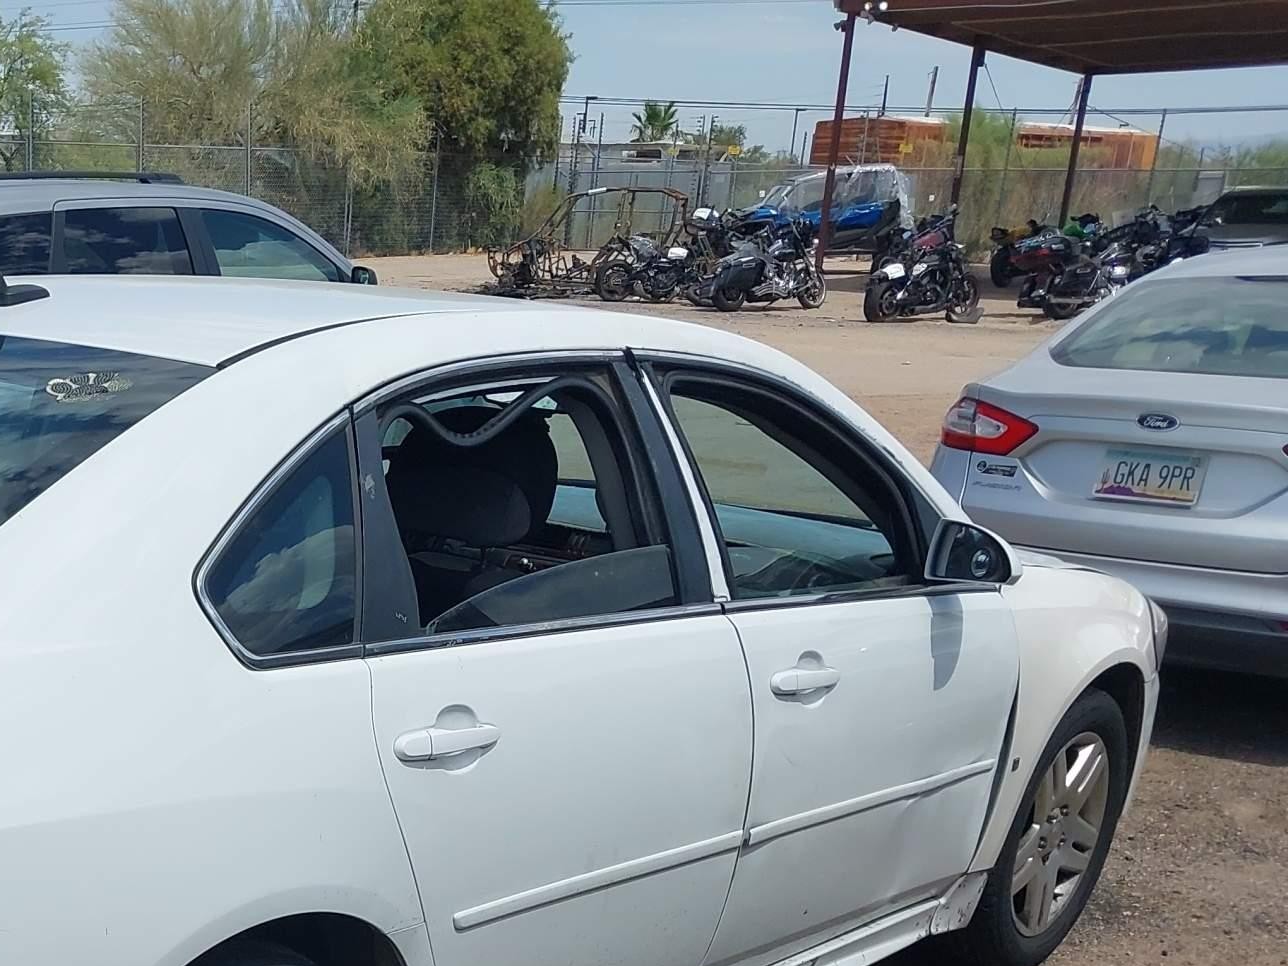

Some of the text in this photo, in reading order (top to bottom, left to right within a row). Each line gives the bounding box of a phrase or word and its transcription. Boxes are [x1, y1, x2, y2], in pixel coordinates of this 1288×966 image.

[1143, 415, 1170, 429] Ford
[1113, 461, 1196, 491] GKA 9PR
